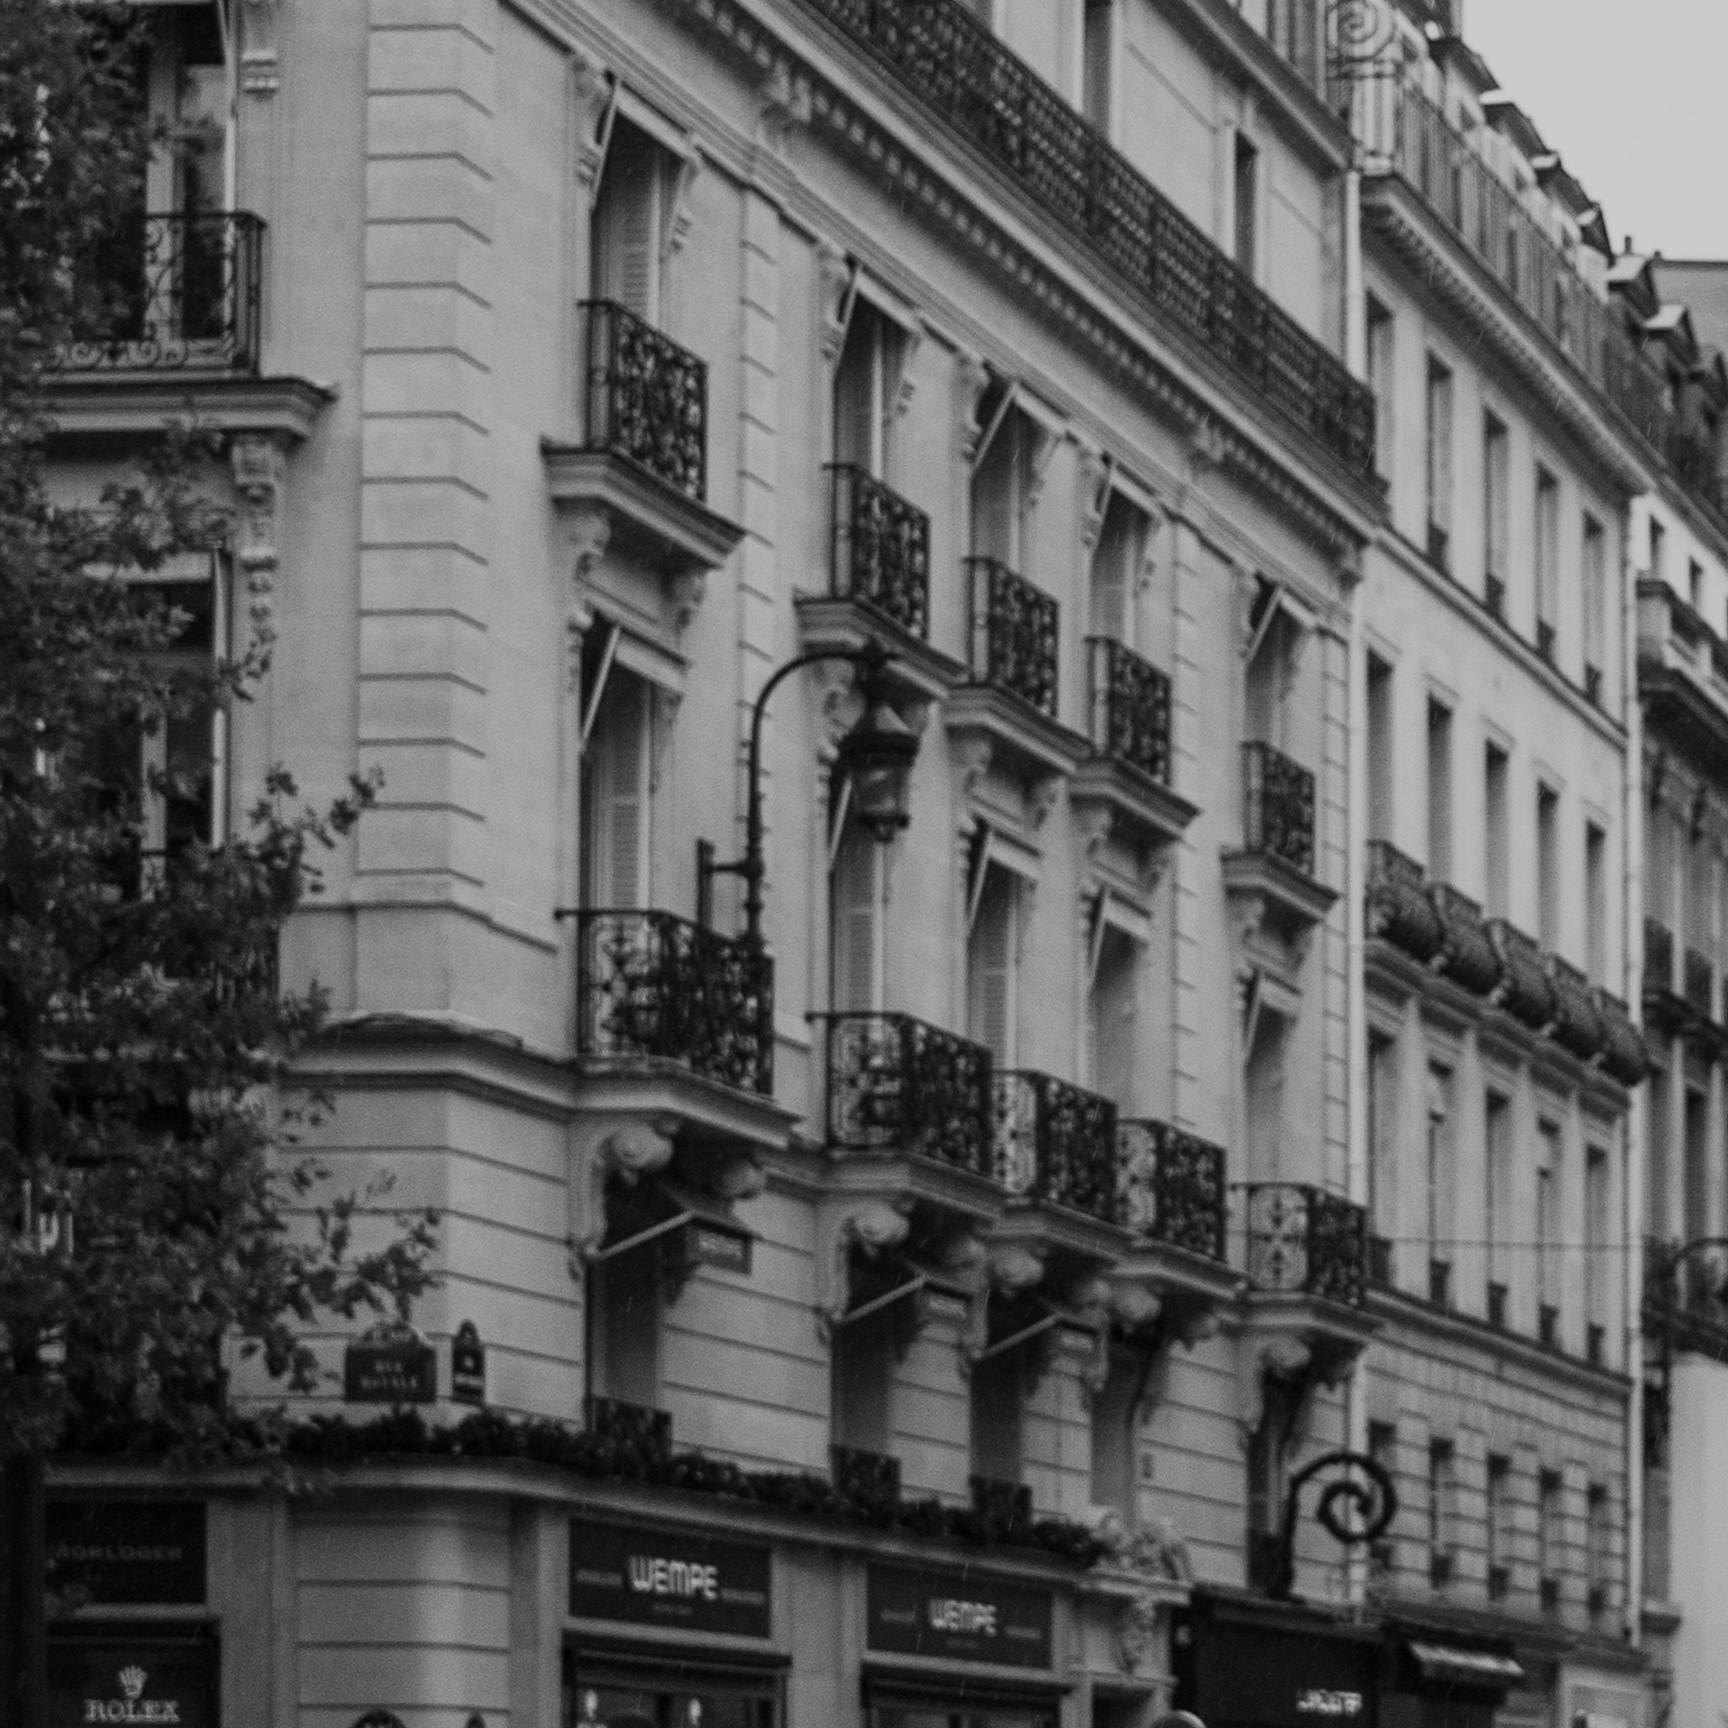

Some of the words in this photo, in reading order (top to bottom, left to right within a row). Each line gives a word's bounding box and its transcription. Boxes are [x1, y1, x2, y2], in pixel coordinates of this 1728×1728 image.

[630, 1556, 719, 1600] WEMPE
[928, 1597, 998, 1637] WEMPE
[84, 1697, 181, 1724] ROLEX
